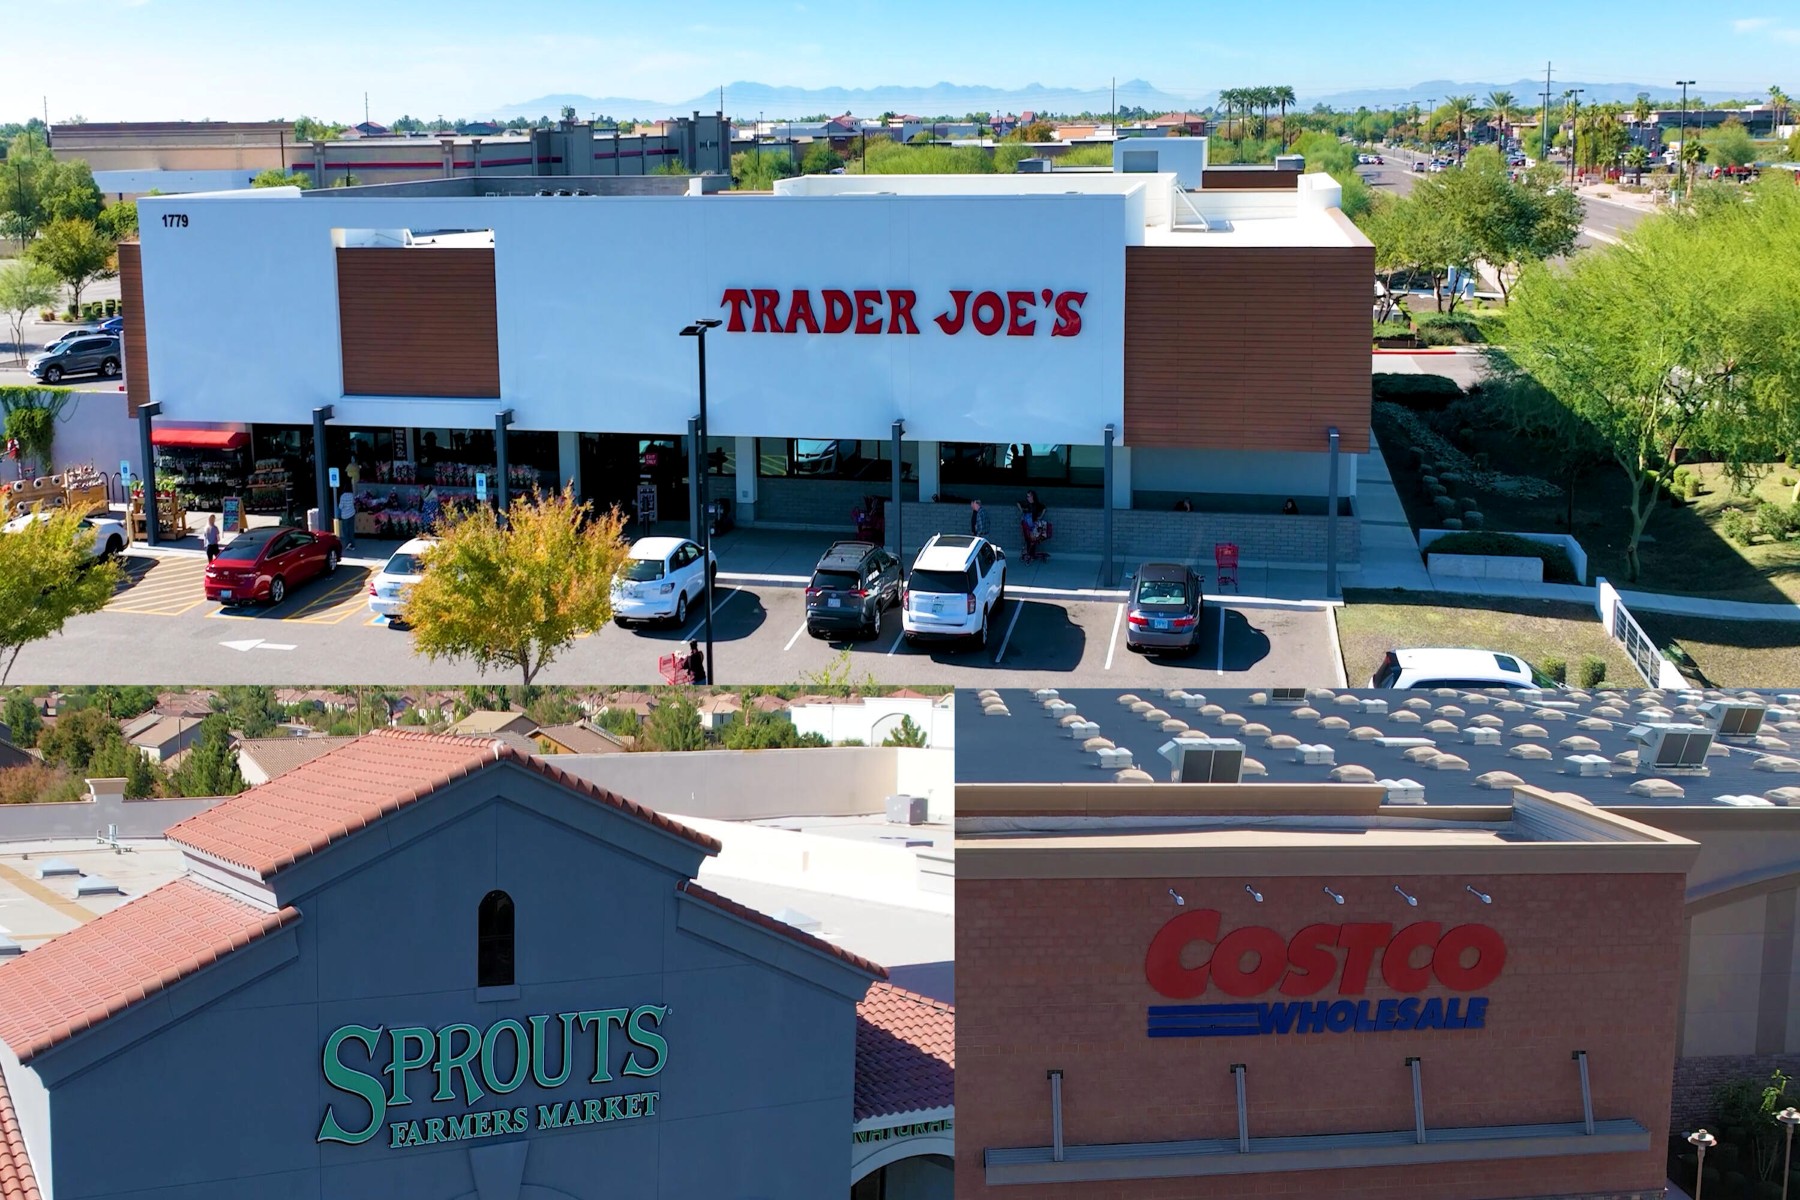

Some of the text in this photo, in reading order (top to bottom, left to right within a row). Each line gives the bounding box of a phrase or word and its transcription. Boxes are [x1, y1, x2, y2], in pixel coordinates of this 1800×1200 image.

[162, 214, 189, 228] 1779
[720, 289, 1088, 337] TRADER JOE'S
[1145, 908, 1507, 999] COSTCO
[1258, 997, 1490, 1035] WHOLESALE
[317, 1004, 670, 1144] SPROUTS
[390, 1091, 661, 1149] FARMERS MARKET
